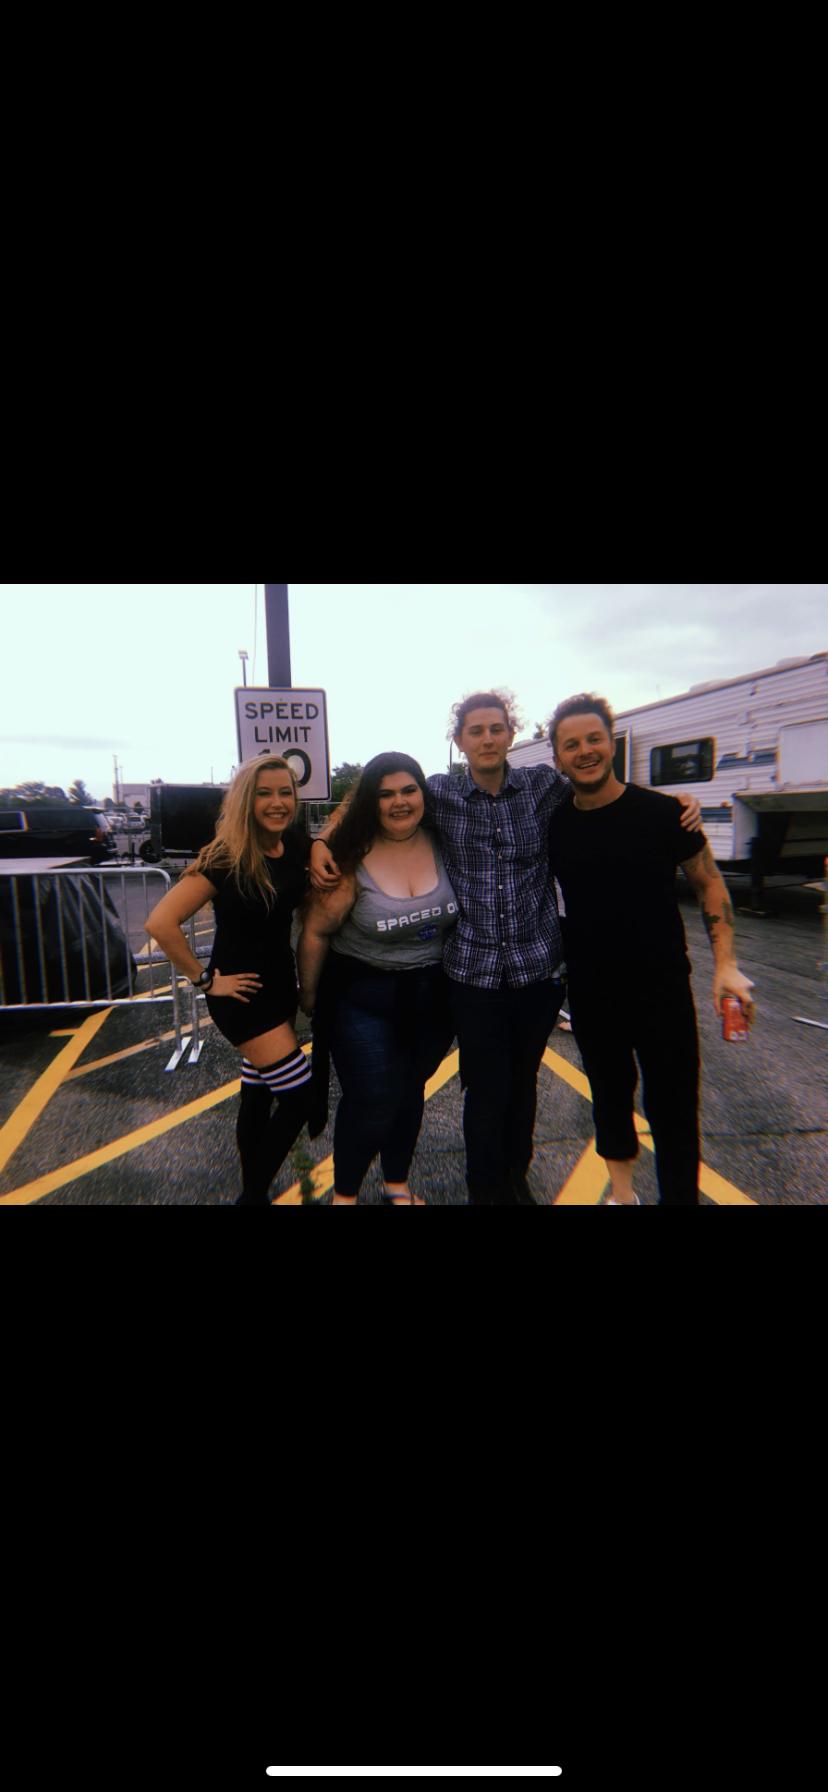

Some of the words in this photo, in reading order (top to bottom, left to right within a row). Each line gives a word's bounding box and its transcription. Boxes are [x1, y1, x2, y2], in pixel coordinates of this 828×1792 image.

[245, 702, 319, 719] SPEED
[254, 726, 311, 742] LIMIT
[258, 748, 312, 788] 0
[376, 906, 442, 932] SPACED
[446, 901, 458, 914] O
